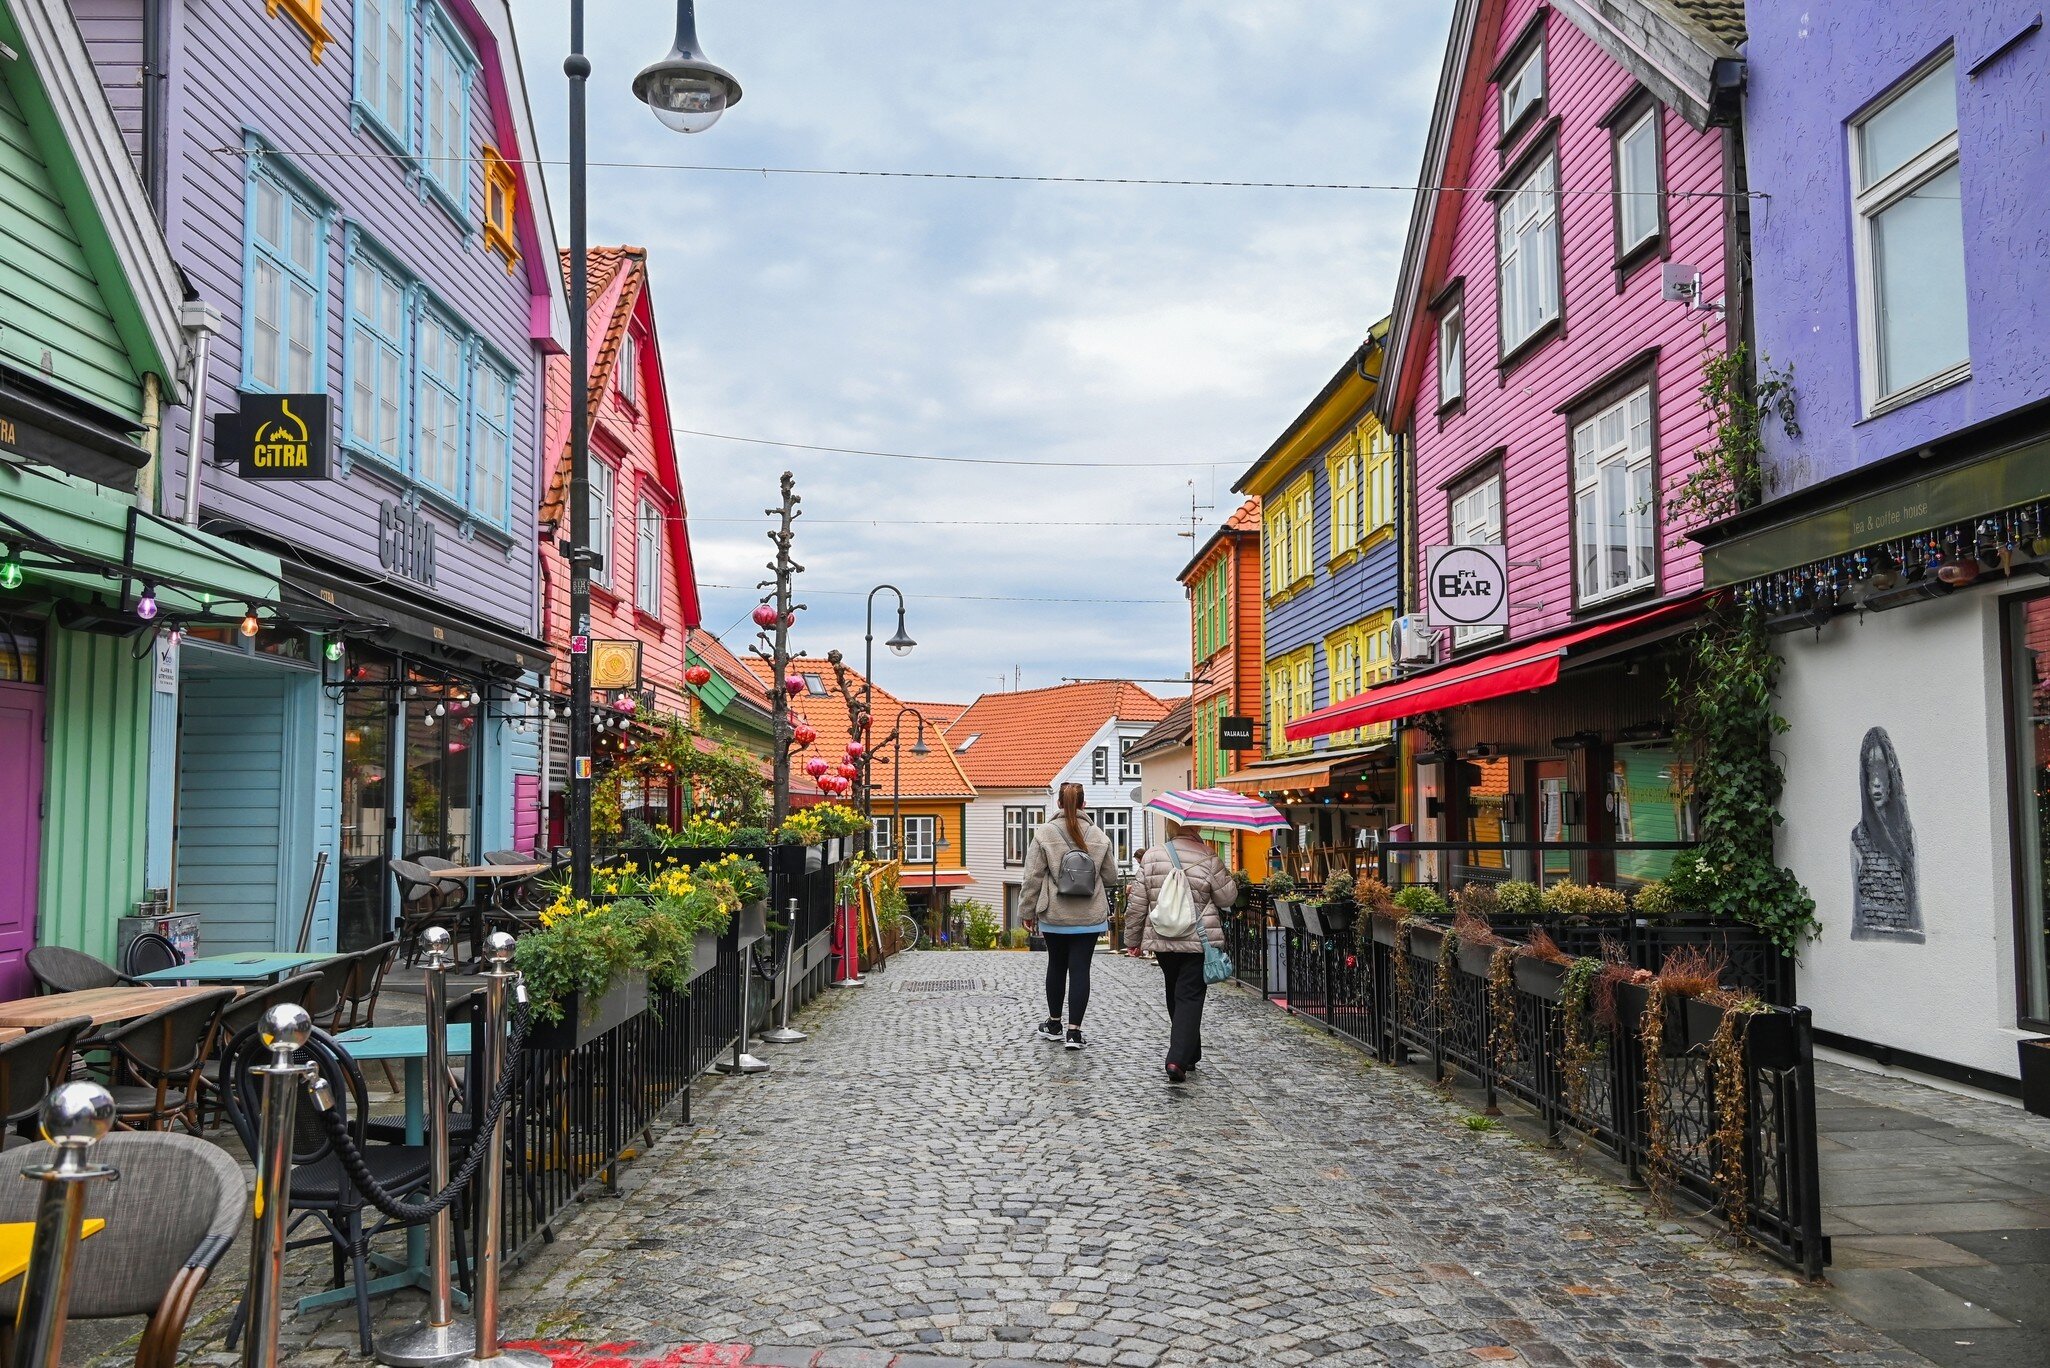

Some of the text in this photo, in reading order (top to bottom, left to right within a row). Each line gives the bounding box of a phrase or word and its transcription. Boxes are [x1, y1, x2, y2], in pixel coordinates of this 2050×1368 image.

[1875, 509, 1901, 529] coffee
[1903, 502, 1928, 519] house
[1458, 569, 1477, 578] Fri
[1439, 574, 1491, 598] BAR
